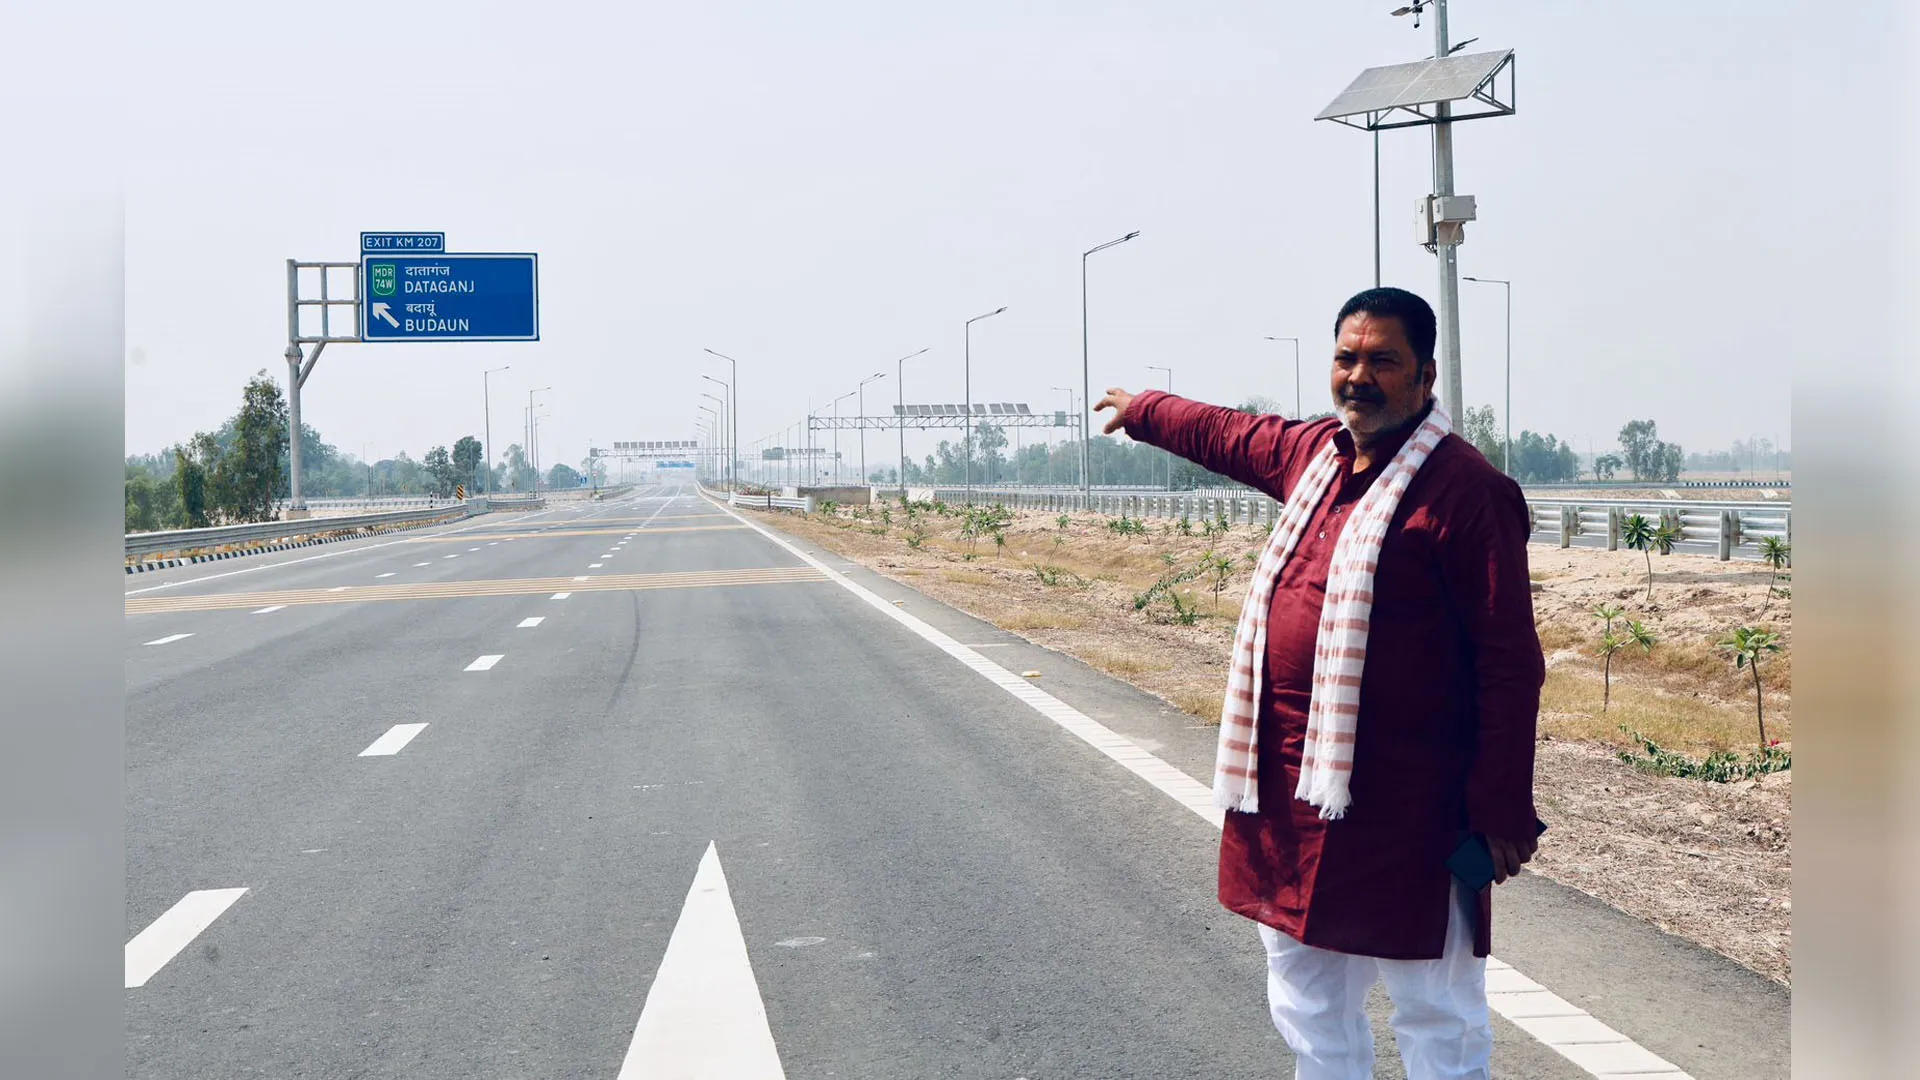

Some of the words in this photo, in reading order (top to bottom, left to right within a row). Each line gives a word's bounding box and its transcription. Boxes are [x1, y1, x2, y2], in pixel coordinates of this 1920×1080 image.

[366, 238, 392, 247] EXIT
[396, 238, 414, 247] KM
[417, 238, 438, 247] 207
[375, 268, 393, 277] MDR
[405, 263, 450, 276] दातागंज
[375, 279, 393, 289] 74W
[404, 280, 475, 293] DATAGANJ
[405, 300, 437, 316] बदायूं
[405, 319, 469, 332] BUDAUN
